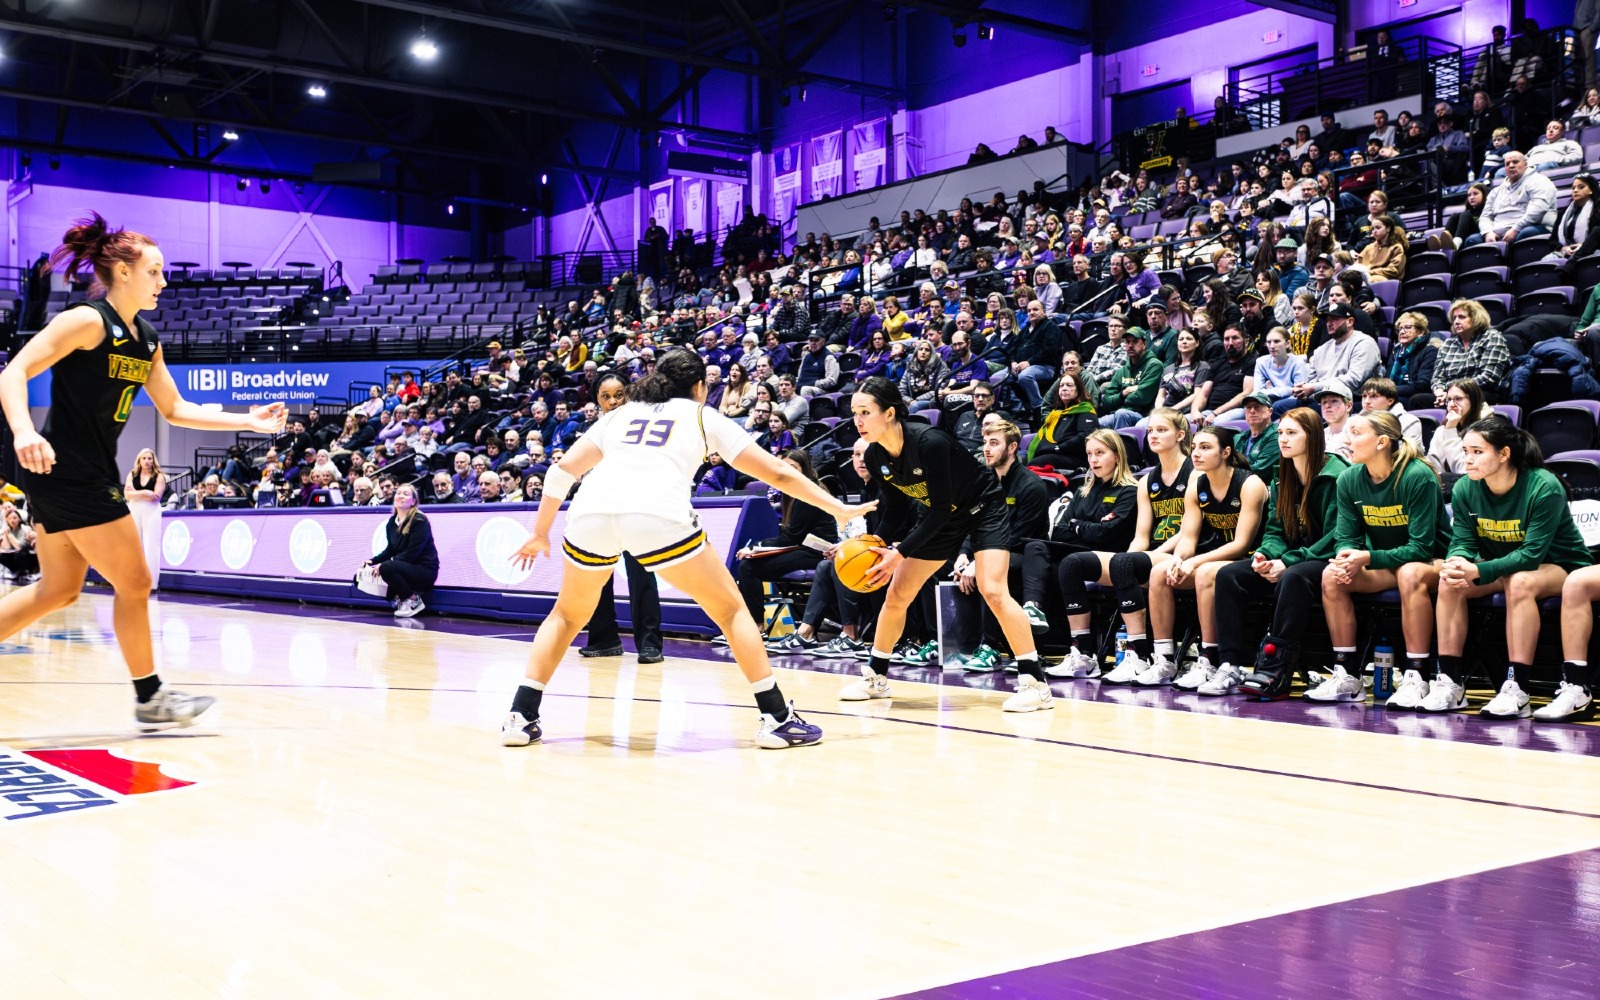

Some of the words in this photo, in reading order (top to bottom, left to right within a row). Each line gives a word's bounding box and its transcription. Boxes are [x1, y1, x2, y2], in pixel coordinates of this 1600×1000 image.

[231, 369, 330, 388] Broadview
[232, 391, 262, 400] Federal
[263, 390, 289, 400] Credit
[290, 390, 315, 399] Union
[620, 418, 676, 448] 33
[1362, 504, 1404, 517] VERMONT
[1153, 513, 1184, 541] 25
[1477, 517, 1521, 531] VERMONT
